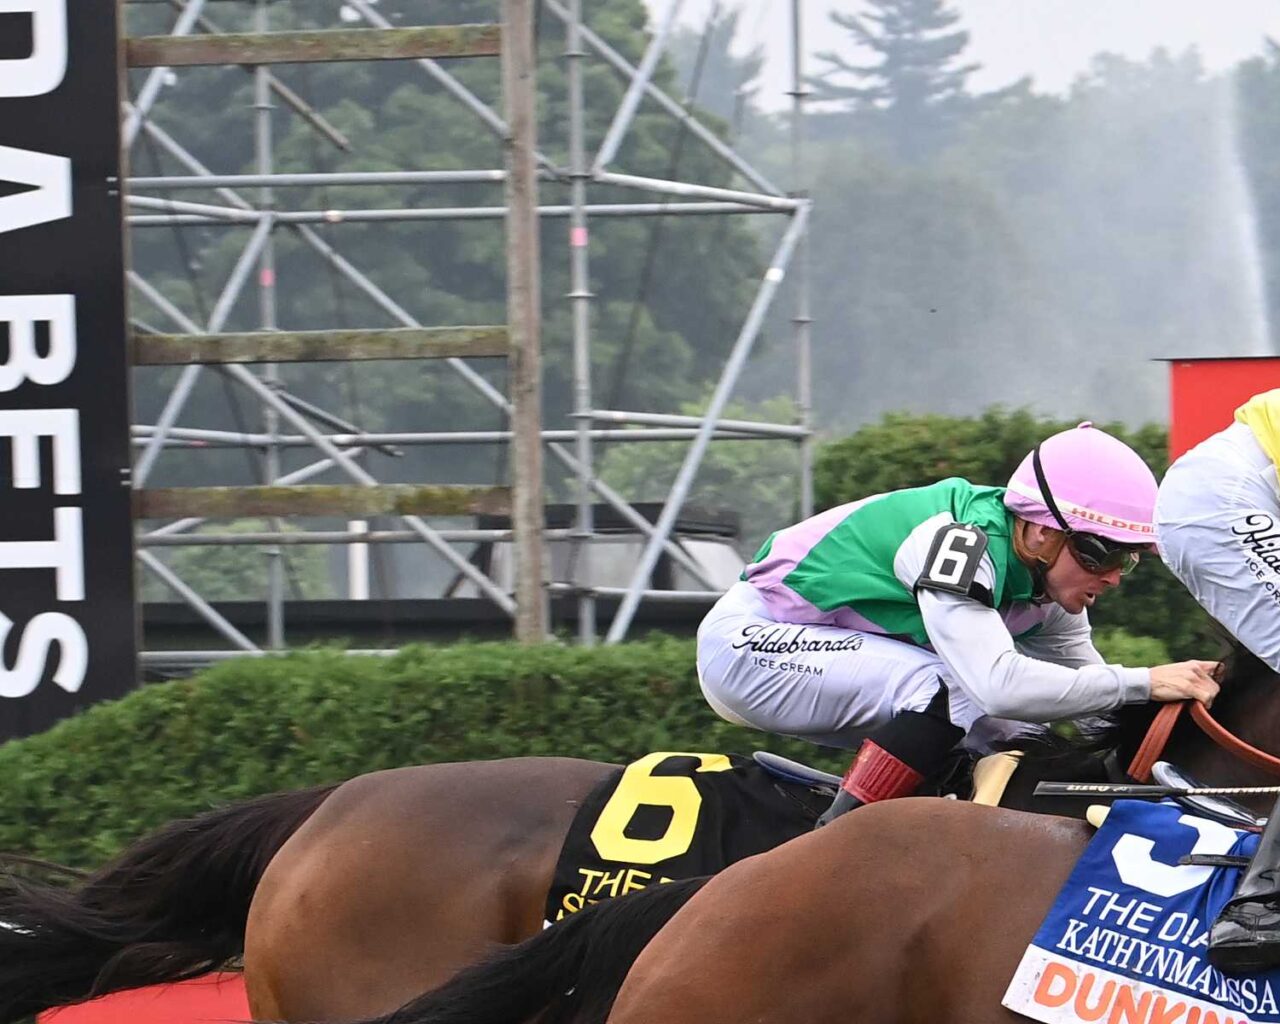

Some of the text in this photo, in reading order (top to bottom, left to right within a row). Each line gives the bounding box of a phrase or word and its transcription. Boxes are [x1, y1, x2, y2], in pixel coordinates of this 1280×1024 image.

[0, 293, 89, 698] BETS
[928, 528, 978, 585] 6
[1244, 557, 1265, 580] ICE
[753, 656, 824, 677] ICE CREAM
[590, 751, 735, 865] 6
[1081, 886, 1164, 934] THE
